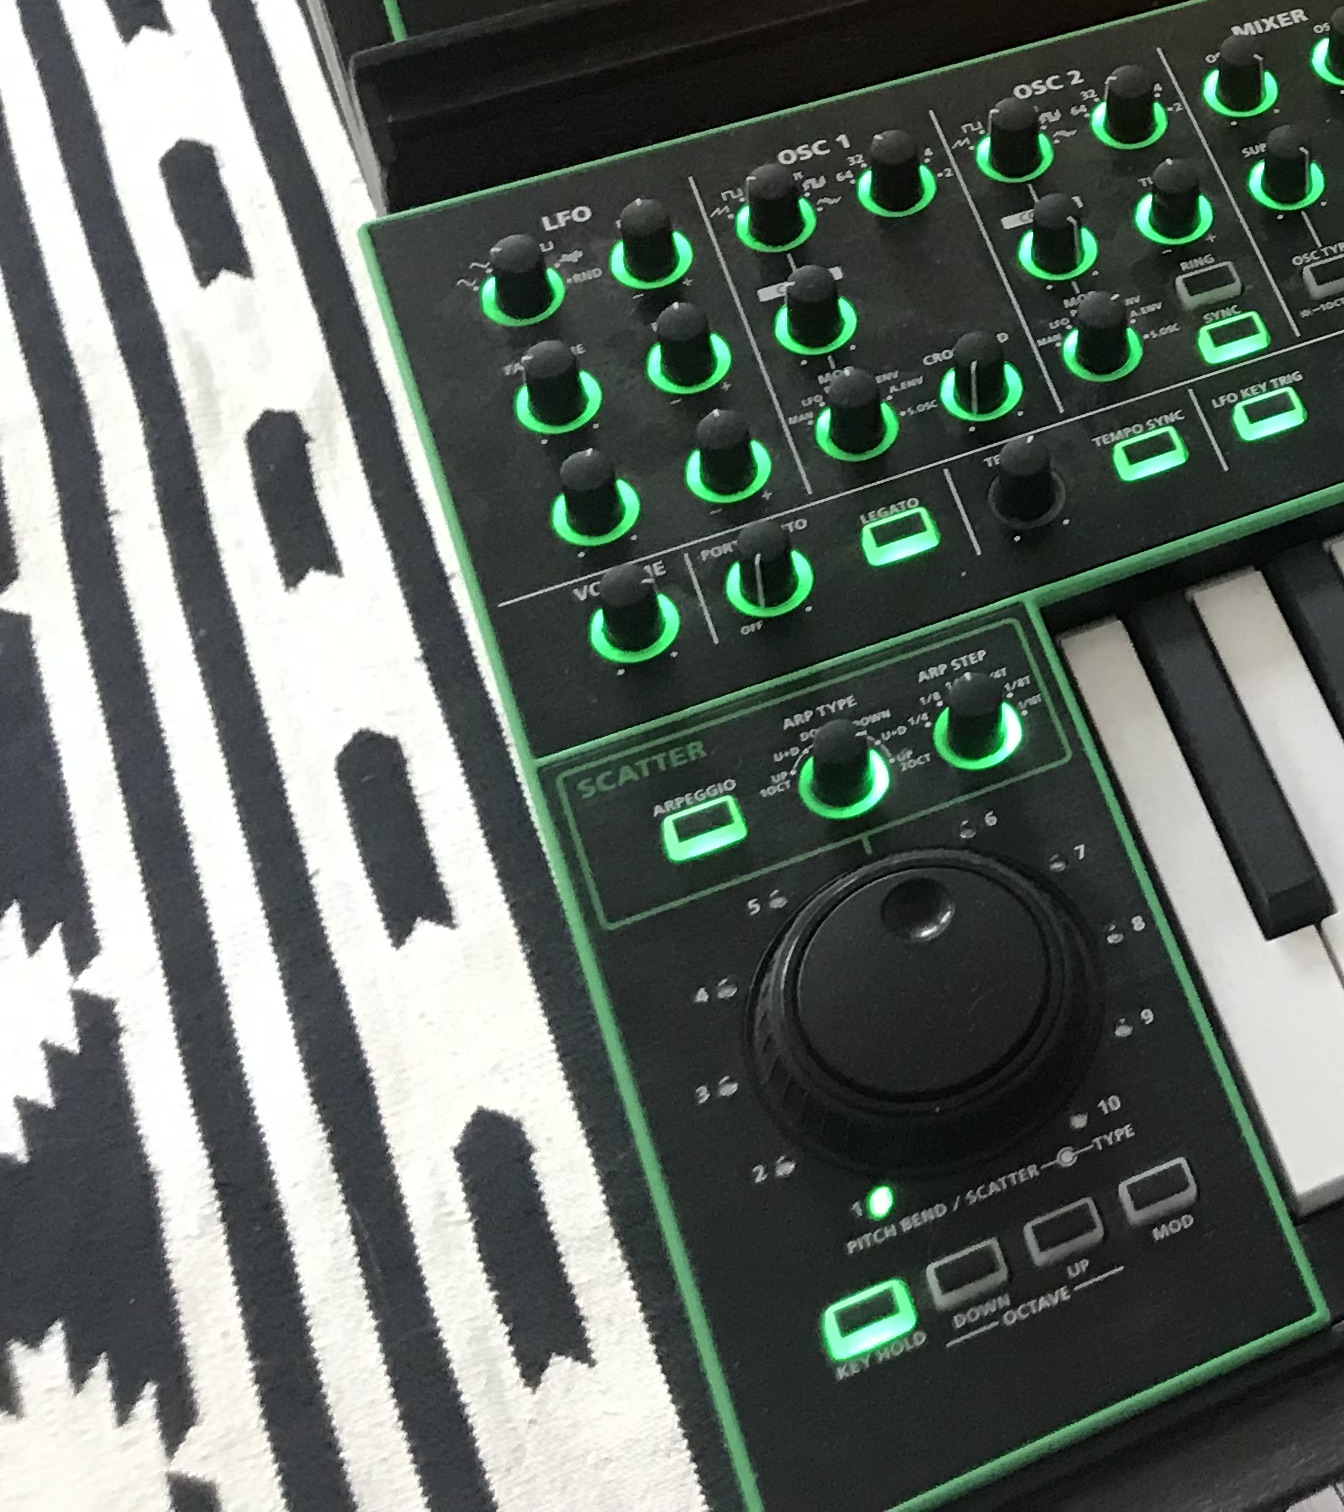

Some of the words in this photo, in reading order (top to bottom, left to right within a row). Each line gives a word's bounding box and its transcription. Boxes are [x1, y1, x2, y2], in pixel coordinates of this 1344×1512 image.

[1230, 8, 1310, 37] MIXER
[1013, 74, 1067, 100] OSC
[1069, 69, 1086, 86] 2
[776, 140, 832, 166] OSC
[835, 133, 852, 150] 1
[541, 204, 593, 232] LFO
[1179, 253, 1215, 272] RING
[1291, 251, 1321, 267] OSC
[1203, 303, 1241, 323] SYNC
[1210, 391, 1238, 411] LFO
[1238, 381, 1267, 402] KEY
[1268, 371, 1304, 393] TRIG
[1091, 423, 1144, 448] TEMPO
[1146, 408, 1187, 433] SYNC
[859, 497, 920, 525] LEGATO
[917, 663, 950, 683] ARP
[949, 649, 988, 674] STEP
[782, 710, 816, 730] ARP
[817, 695, 858, 717] TYPE
[576, 741, 708, 800] SCATTER
[652, 778, 738, 818] ARPEGGIO
[1091, 1123, 1136, 1152] TYPE
[845, 1222, 898, 1255] PITCH
[898, 1202, 948, 1234] BEND
[964, 1163, 1041, 1206] SCATTER
[1152, 1214, 1196, 1243] MOD
[1065, 1258, 1091, 1279] UP
[951, 1292, 1011, 1330] DOWN
[1003, 1285, 1073, 1327] OCTAVE
[836, 1355, 873, 1382] KEY
[875, 1330, 928, 1369] HOLD
